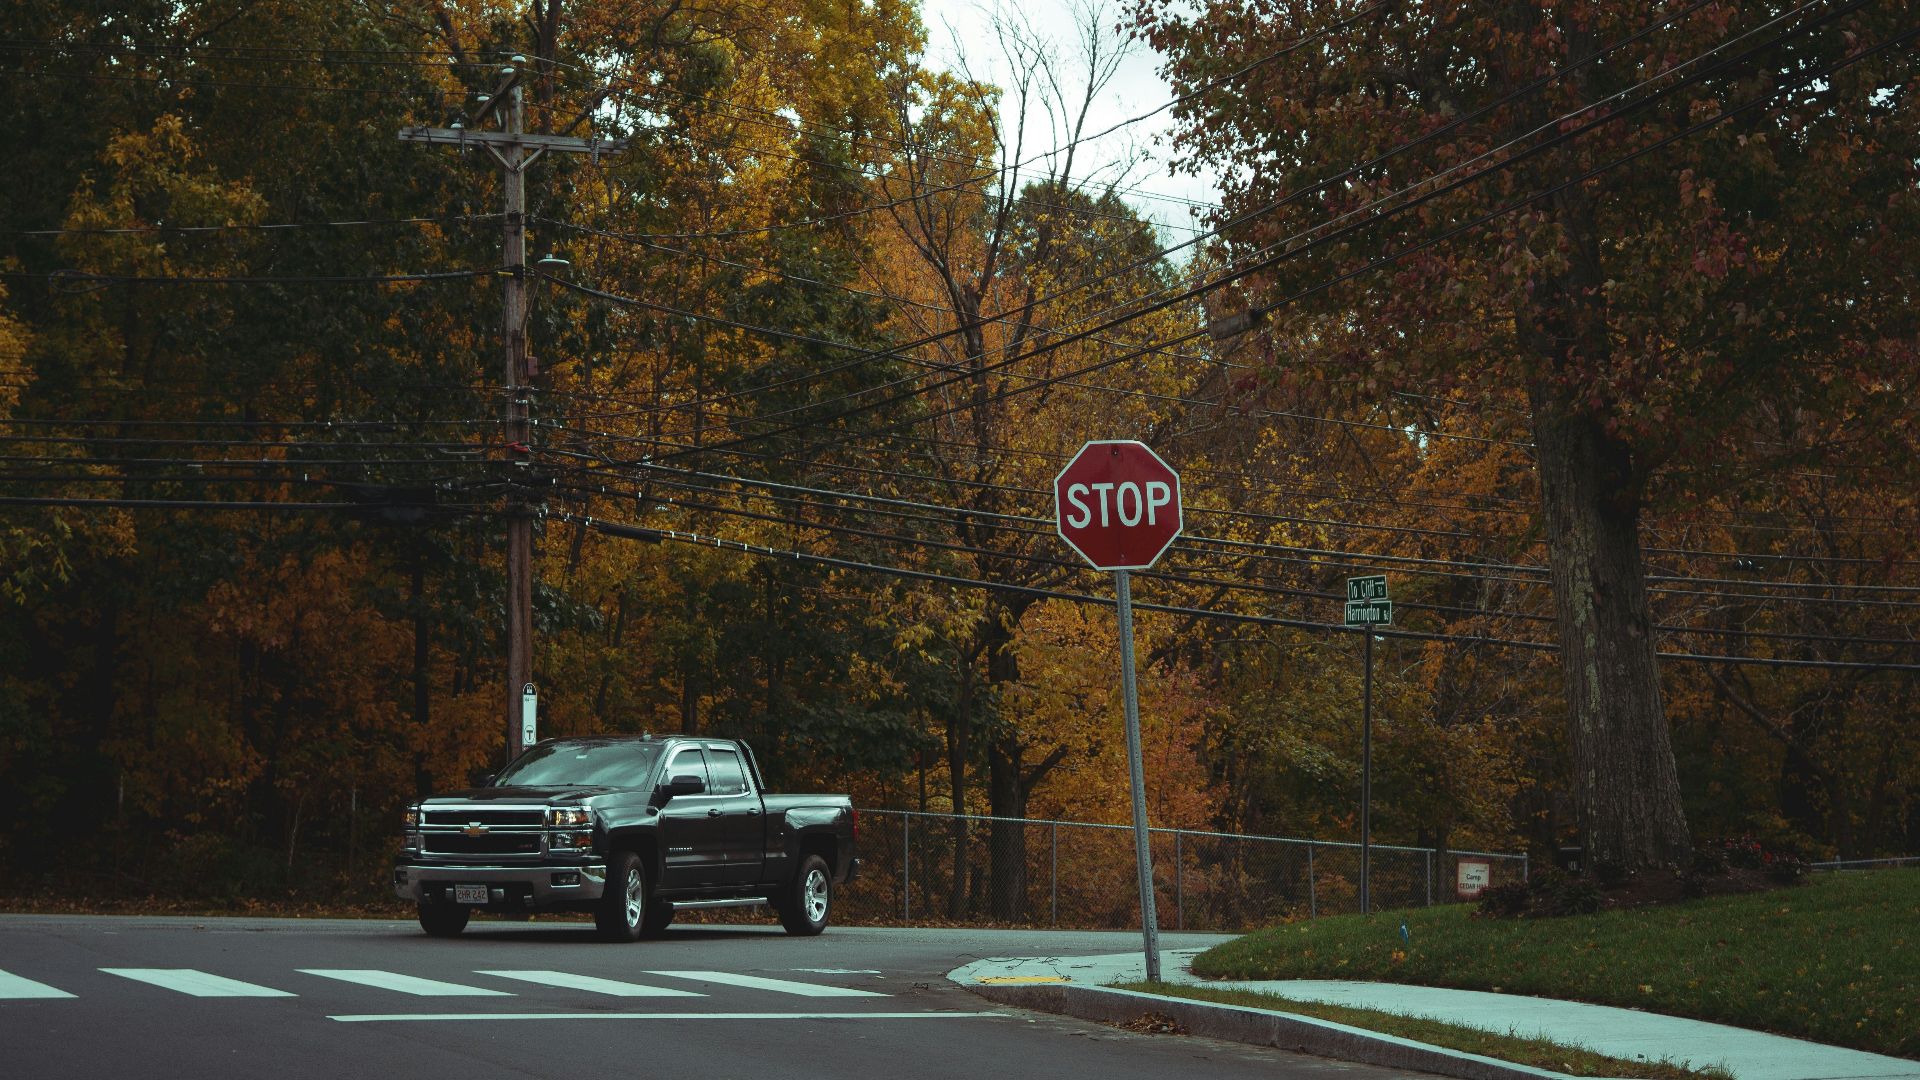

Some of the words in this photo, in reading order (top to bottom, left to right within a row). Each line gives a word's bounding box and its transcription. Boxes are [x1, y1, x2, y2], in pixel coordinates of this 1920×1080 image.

[1067, 481, 1171, 529] STOP
[1349, 581, 1358, 599] To
[1361, 580, 1375, 598] Cliff
[1347, 604, 1380, 624] Harrington
[526, 730, 533, 740] T
[1466, 873, 1482, 881] Camp
